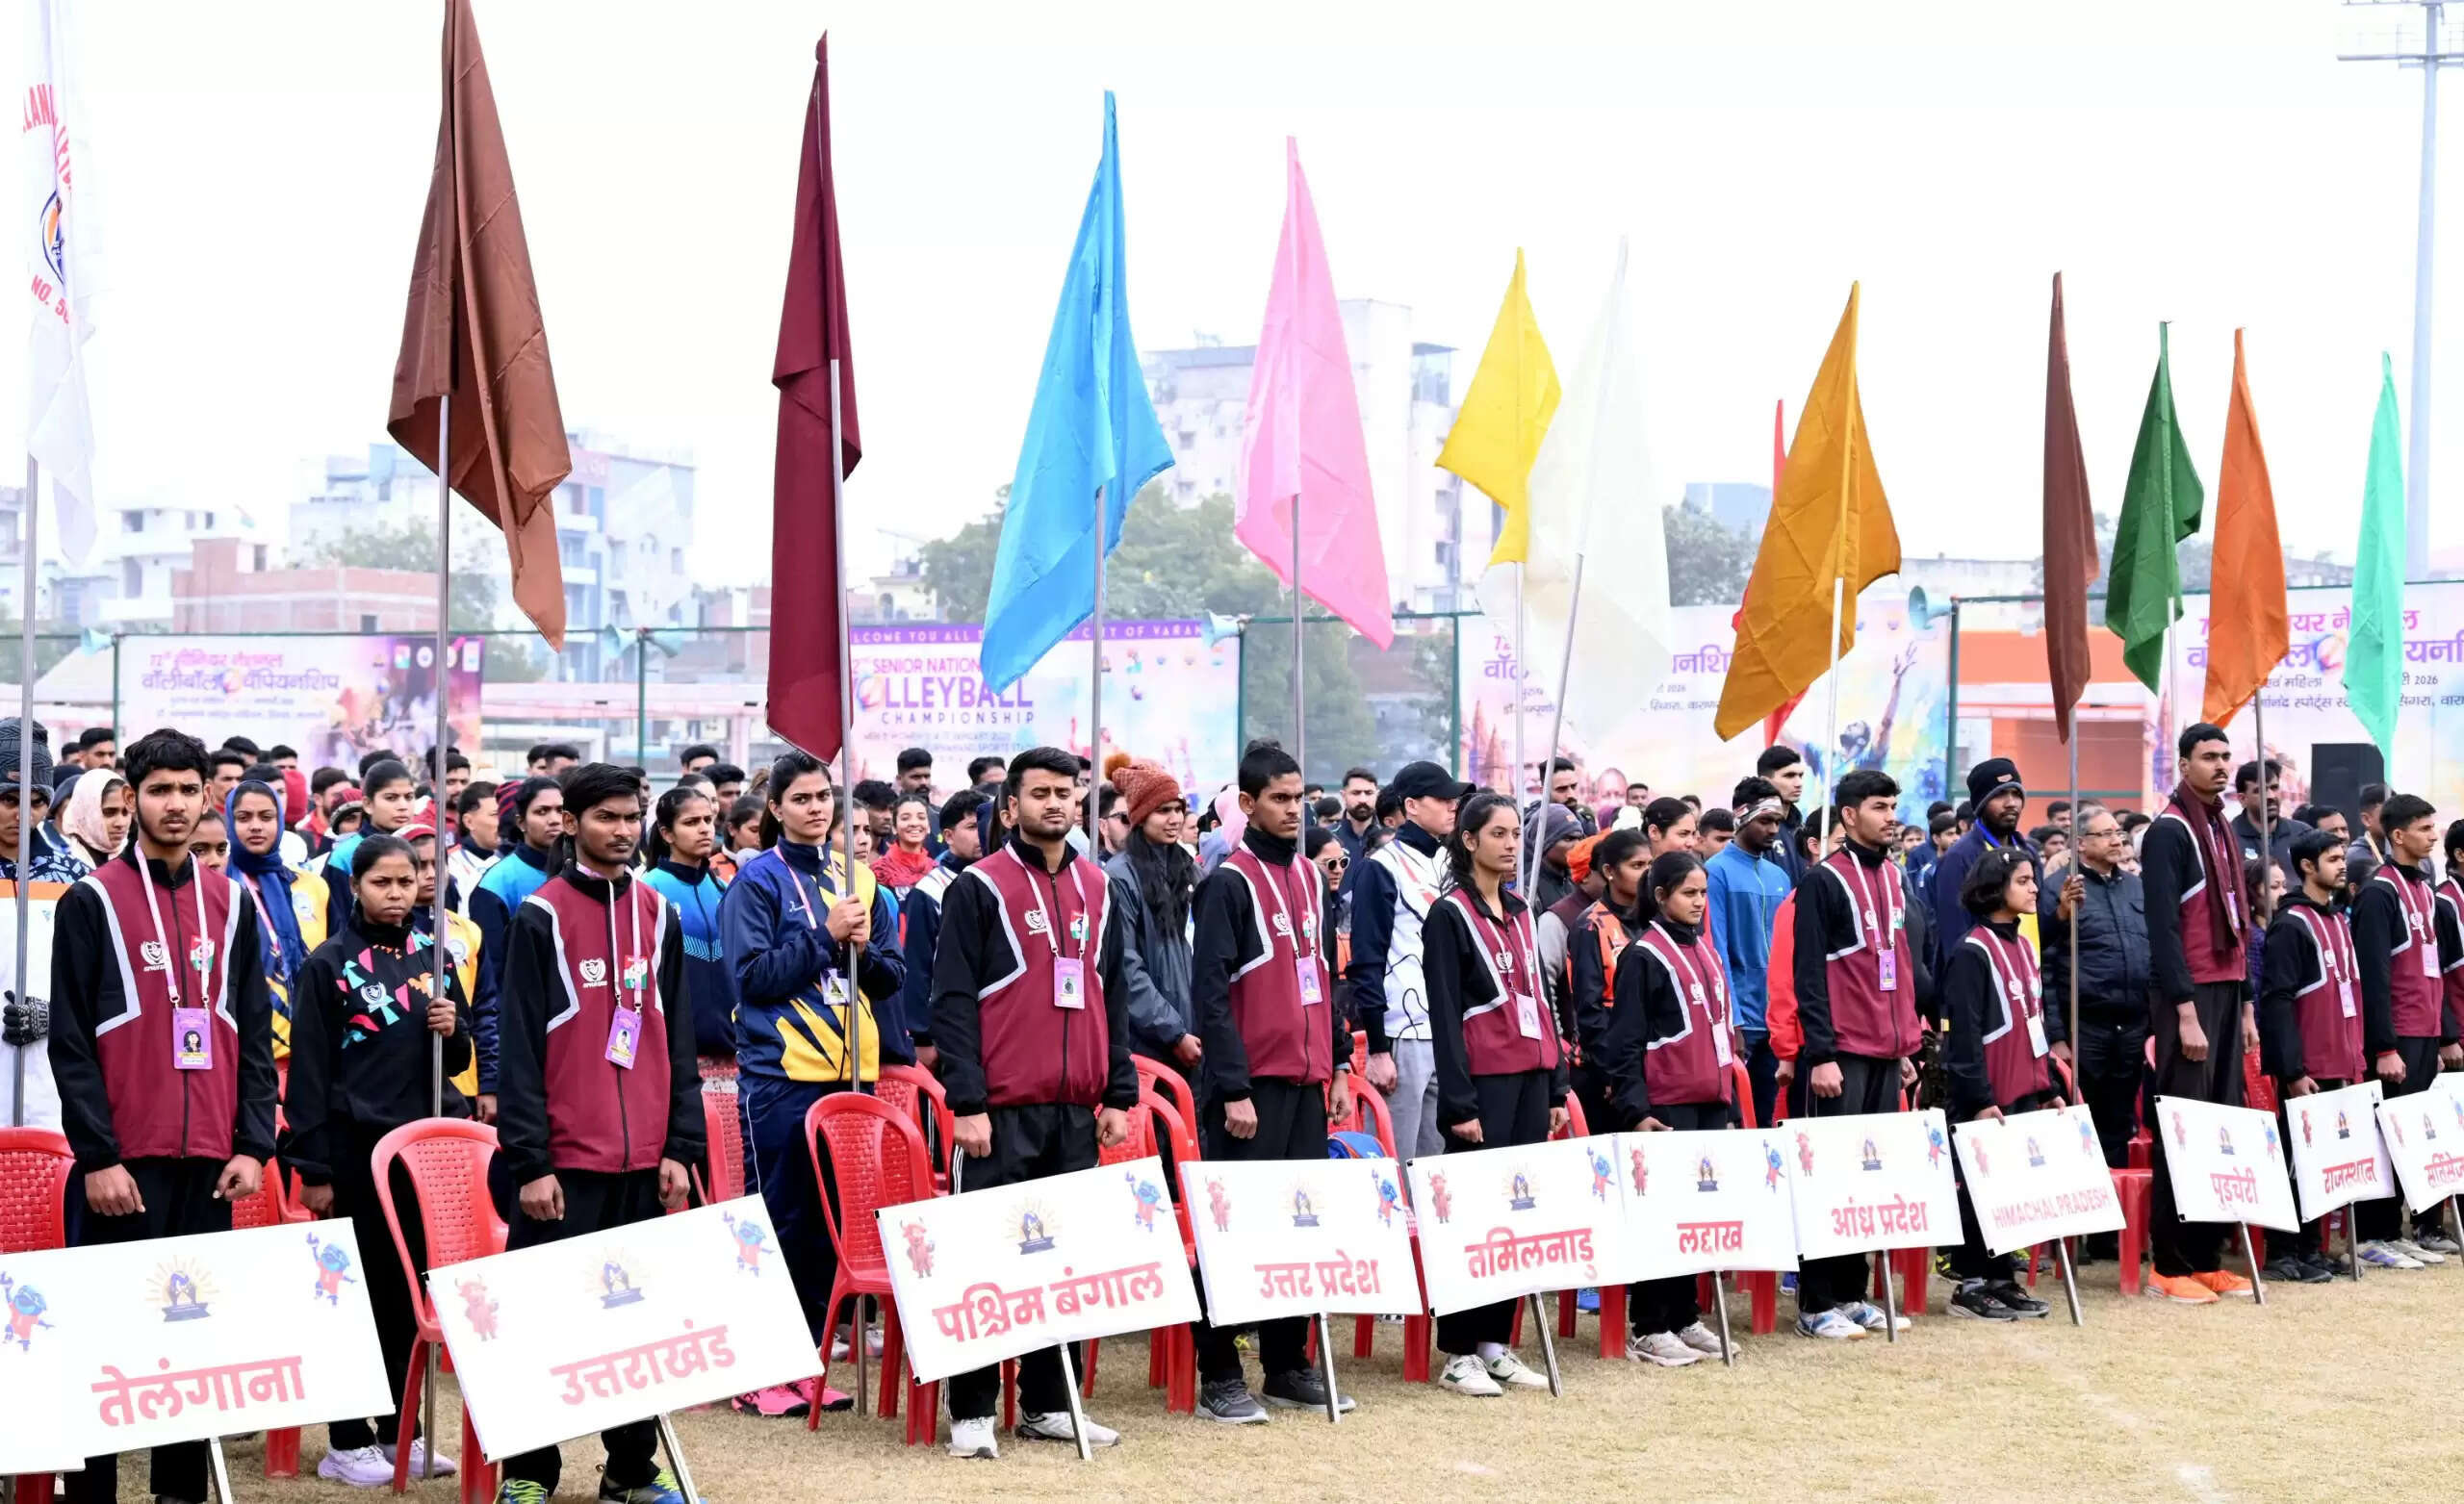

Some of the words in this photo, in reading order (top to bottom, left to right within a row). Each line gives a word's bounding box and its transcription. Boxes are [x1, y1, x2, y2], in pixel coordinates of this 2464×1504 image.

[853, 630, 902, 644] LCOME
[909, 630, 937, 643] YOU
[944, 630, 970, 642] ALL
[1125, 625, 1144, 637] OF
[873, 657, 923, 674] SENIOR
[927, 657, 981, 674] NATION
[2414, 675, 2439, 686] 2026
[881, 711, 1035, 725] CHAMPIONSHIP
[2322, 1157, 2377, 1193] राजस्थान
[1877, 1193, 1928, 1236] प्रदेश
[1991, 1197, 2059, 1229] HIMACHAL
[2056, 1185, 2112, 1218] PRADESH
[1463, 1226, 1596, 1281] तमिलनाडु
[1676, 1220, 1744, 1255] लद्दाख
[1255, 1262, 1313, 1299] उत्तर
[1315, 1249, 1380, 1297] प्रदेश
[932, 1282, 1045, 1342] पश्चिम
[1049, 1262, 1163, 1315] बंगाल
[550, 1317, 736, 1406] उत्तराखंड
[91, 1356, 306, 1427] तेलंगाना
